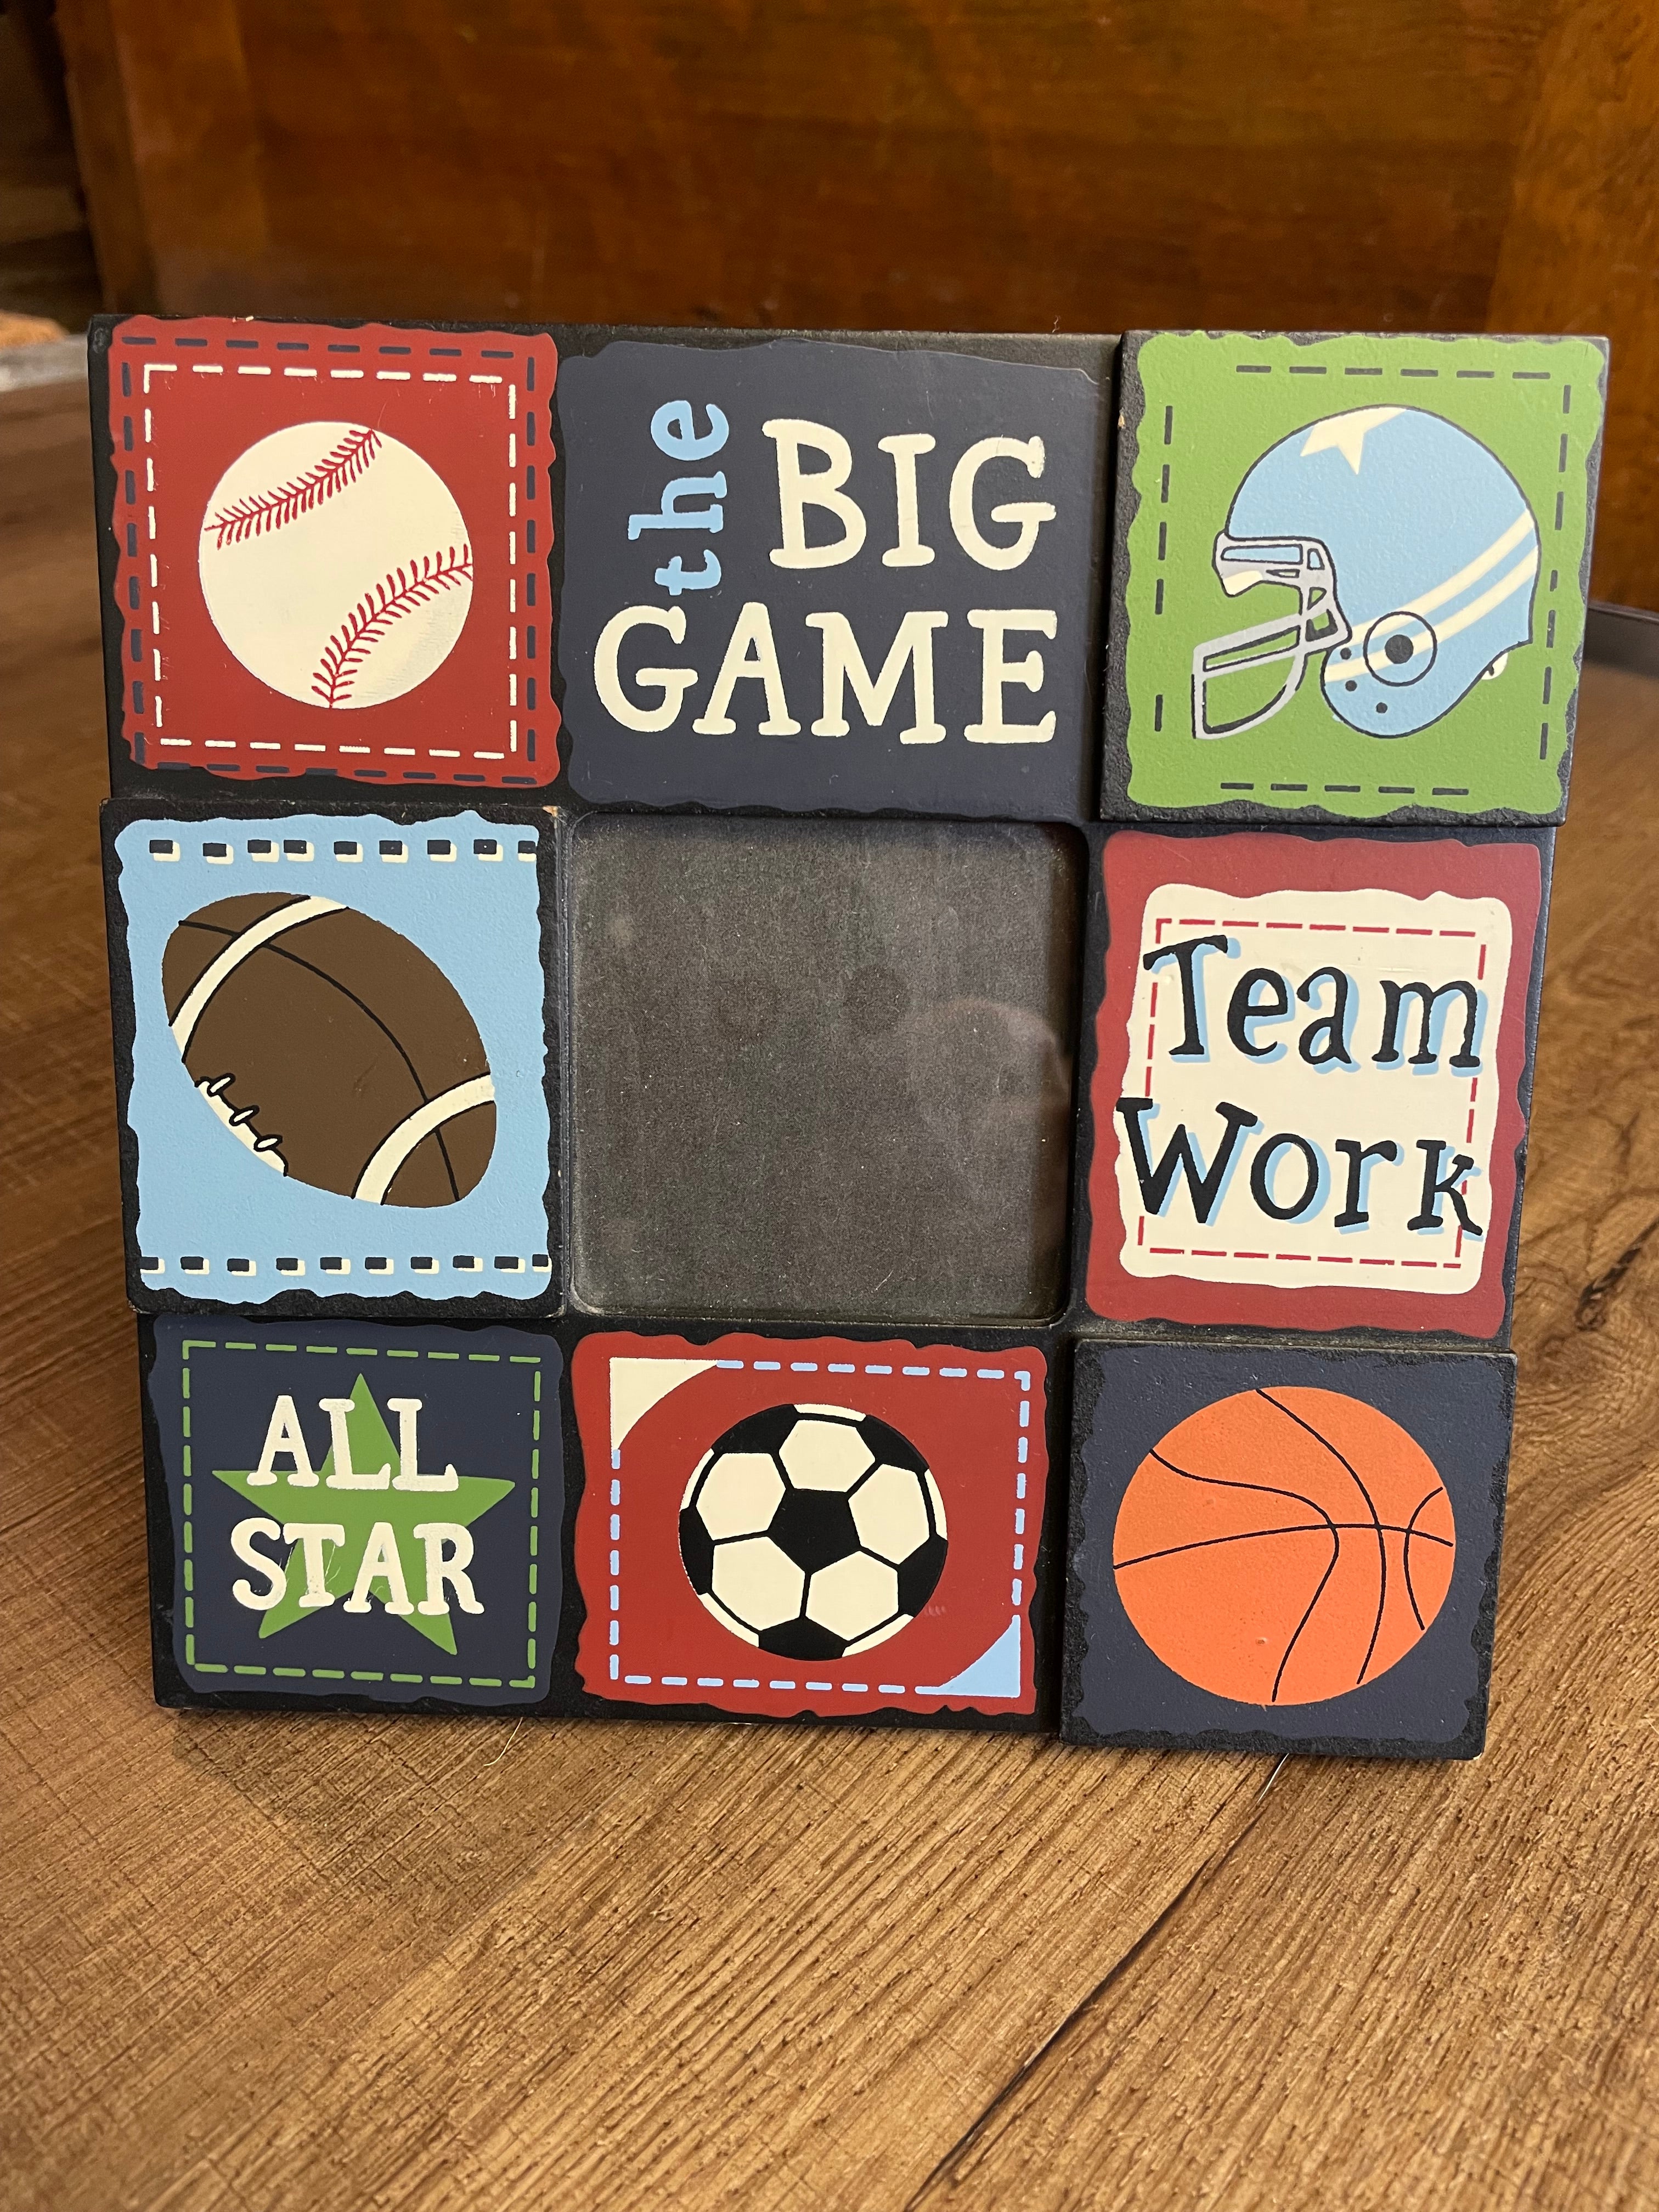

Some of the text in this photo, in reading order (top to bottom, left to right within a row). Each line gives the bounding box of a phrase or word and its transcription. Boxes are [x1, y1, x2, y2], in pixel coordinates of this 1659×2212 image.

[628, 400, 729, 596] the
[761, 419, 1057, 571] BIG
[594, 601, 1058, 744] GAME
[1143, 935, 1483, 1071] Team
[1116, 1097, 1483, 1237] Work
[247, 1395, 459, 1492] ALL
[230, 1517, 484, 1616] STAR
